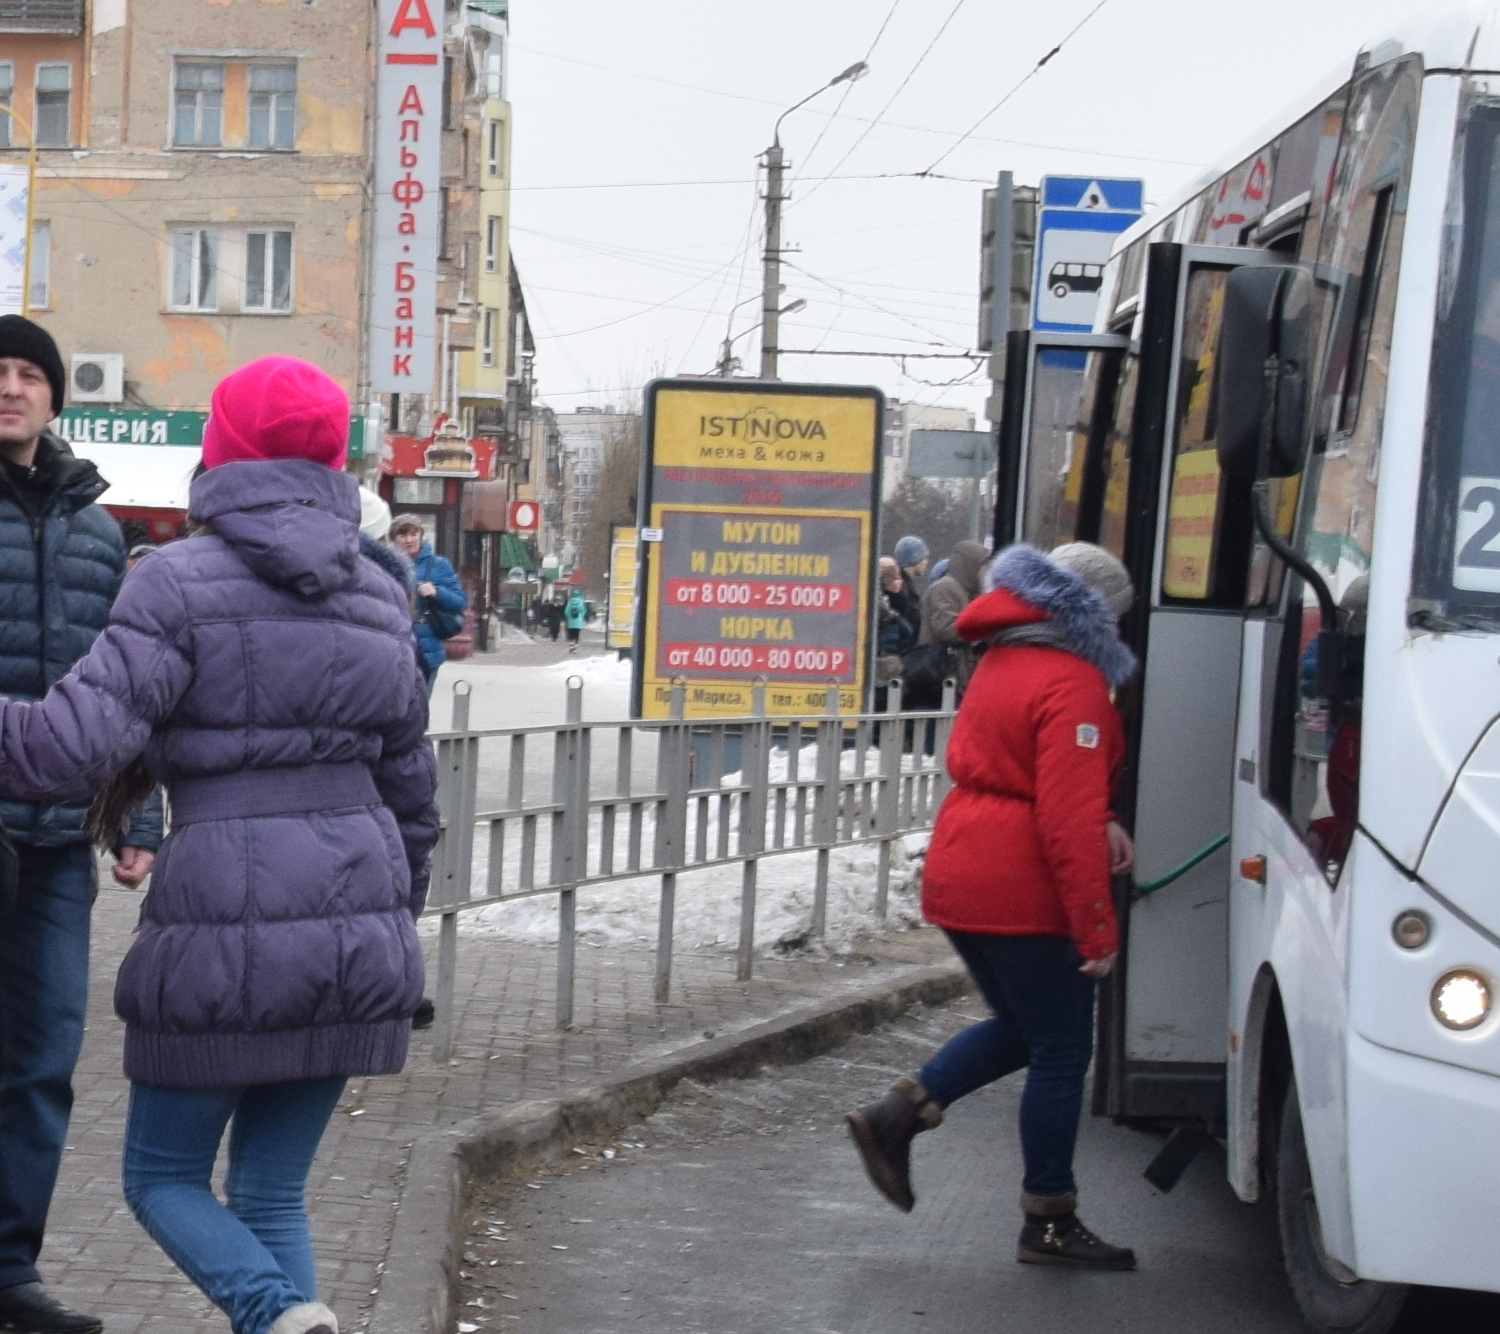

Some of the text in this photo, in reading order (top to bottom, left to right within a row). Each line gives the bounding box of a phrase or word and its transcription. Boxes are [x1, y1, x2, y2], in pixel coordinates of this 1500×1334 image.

[700, 446, 825, 463] меха & кожа
[722, 521, 800, 544] МУТОН
[690, 551, 830, 578] И ДУБЛЕНКИ
[677, 587, 698, 602] от
[701, 583, 713, 603] 8
[717, 585, 750, 605] 000
[765, 585, 787, 607] 25
[790, 587, 824, 608] 000
[720, 616, 794, 642] НОРКА
[669, 651, 691, 666] от
[693, 647, 716, 666] 40
[720, 648, 753, 667] 000
[768, 650, 791, 669] 80
[795, 651, 828, 671] 000
